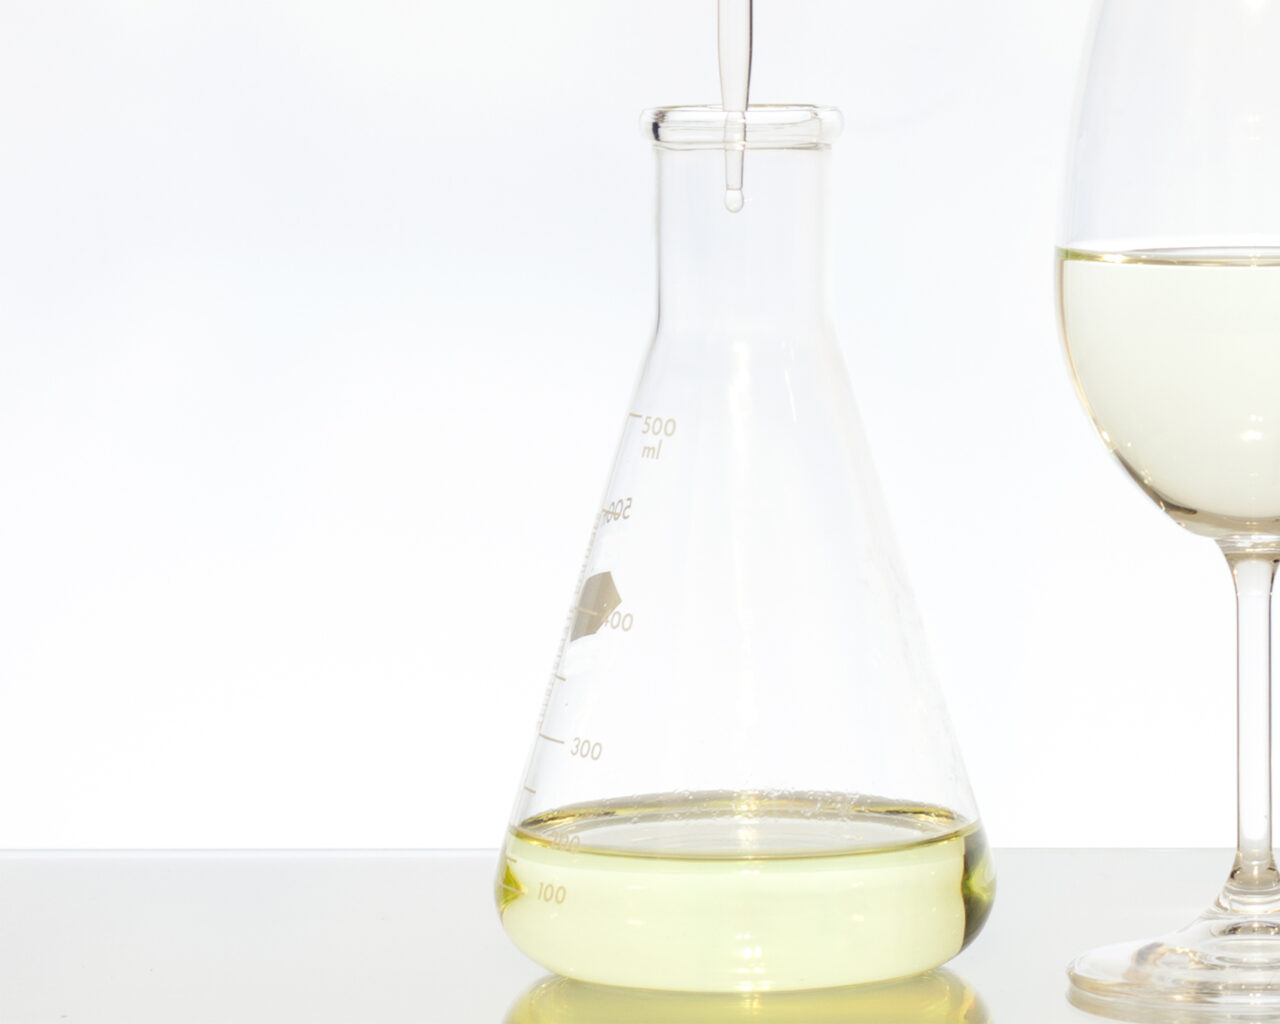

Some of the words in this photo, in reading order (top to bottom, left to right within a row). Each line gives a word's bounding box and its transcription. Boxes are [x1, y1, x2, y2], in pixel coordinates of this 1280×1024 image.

[641, 416, 677, 437] 500
[641, 439, 663, 460] ml
[570, 737, 603, 761] 300
[537, 882, 567, 905] 100
